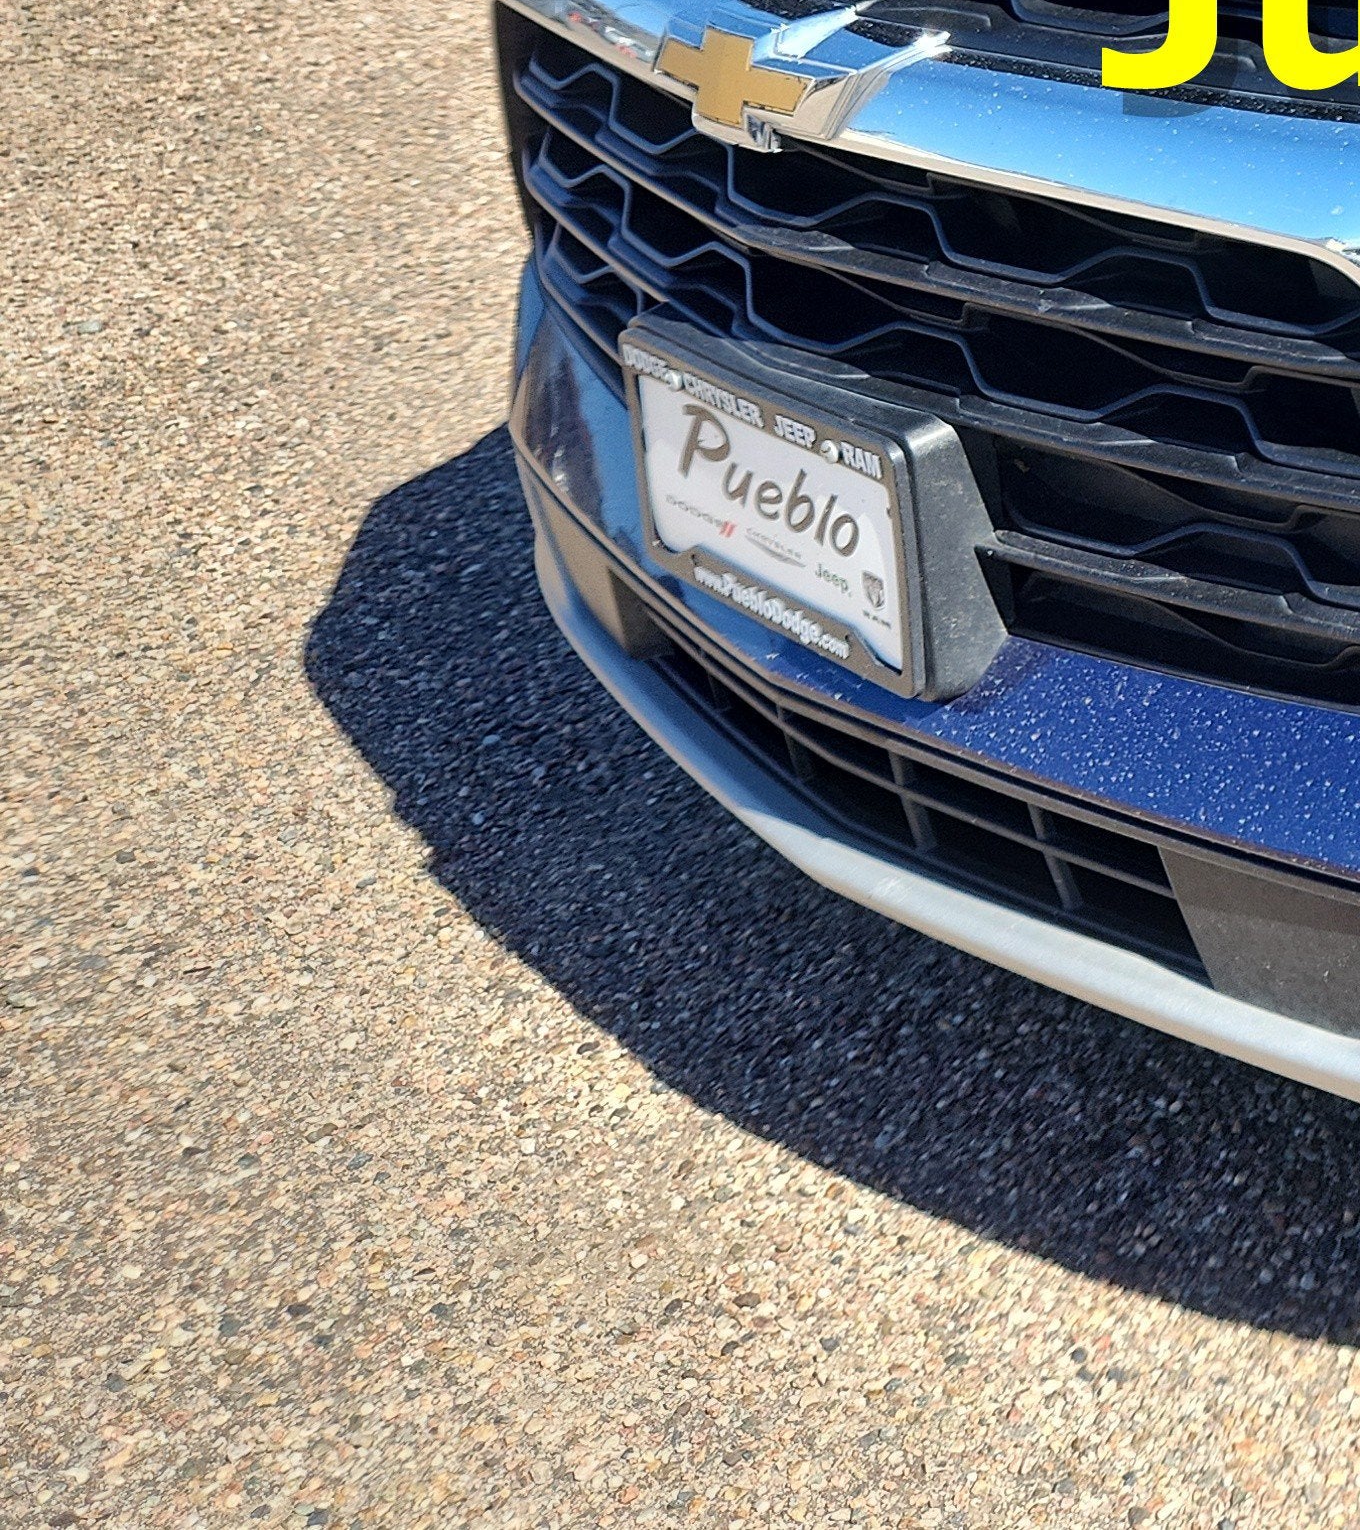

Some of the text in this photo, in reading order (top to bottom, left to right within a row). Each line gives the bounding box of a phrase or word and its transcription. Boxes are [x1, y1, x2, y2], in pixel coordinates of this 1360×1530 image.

[678, 404, 860, 558] Pueblo
[774, 414, 817, 449] JEEP
[840, 441, 882, 479] RAM
